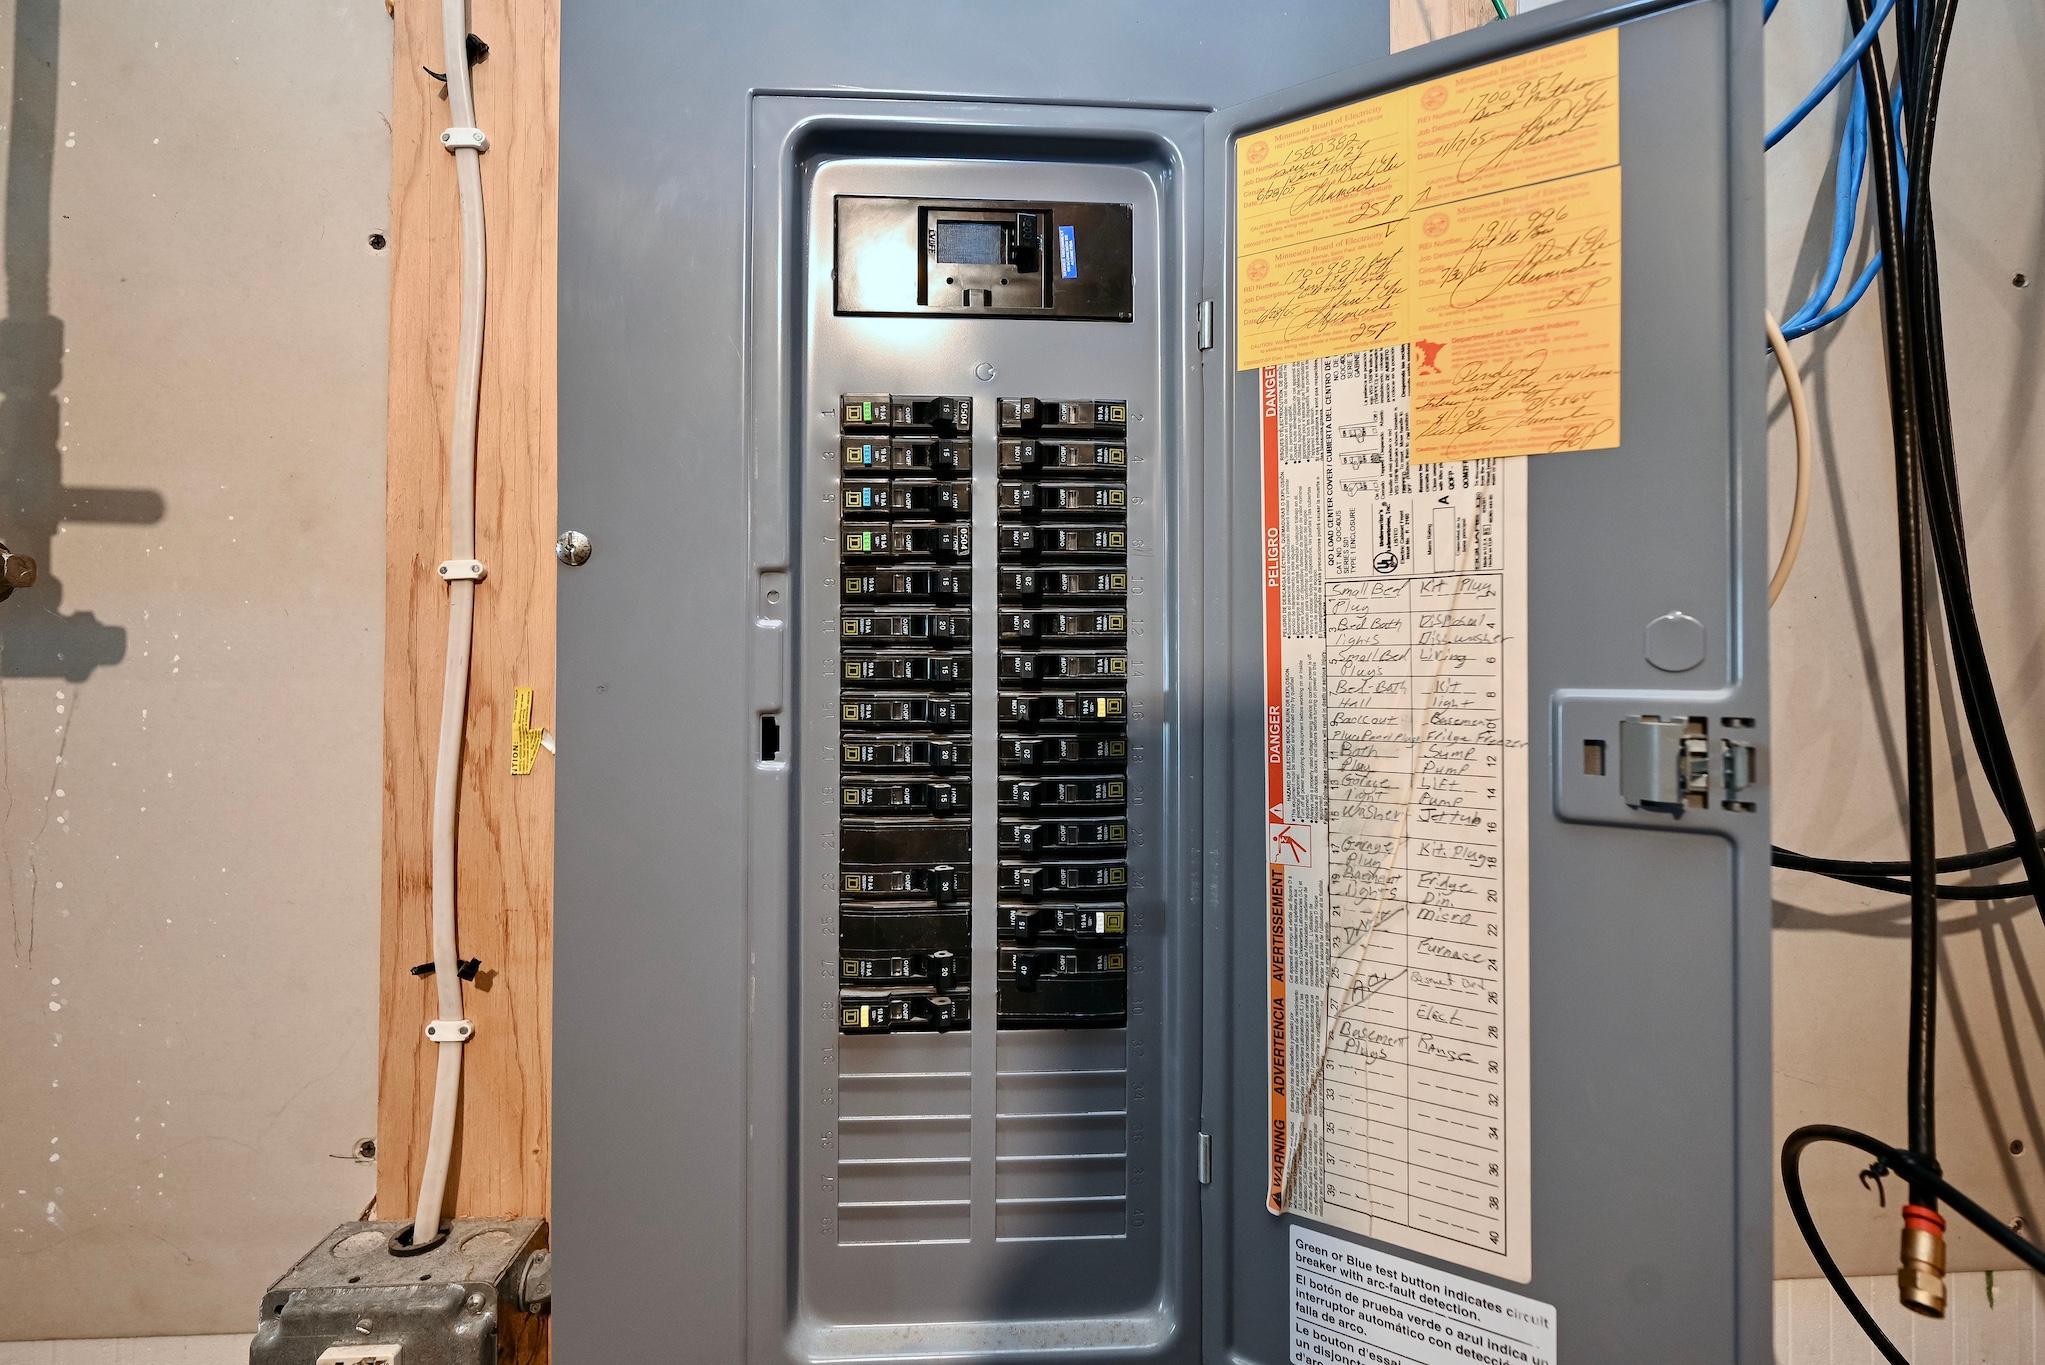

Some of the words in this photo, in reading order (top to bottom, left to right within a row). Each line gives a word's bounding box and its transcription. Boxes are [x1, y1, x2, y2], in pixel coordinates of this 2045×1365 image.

[1311, 120, 1334, 133] Board
[1334, 117, 1343, 126] of
[1344, 105, 1383, 123] Electricity
[1312, 243, 1334, 254] Board
[1335, 238, 1344, 247] of
[1344, 231, 1383, 246] Electricity
[1324, 360, 1332, 371] DE
[1324, 372, 1332, 405] CENTRO
[1325, 407, 1333, 422] DEL
[1325, 423, 1333, 463] CUBIERTA
[1326, 468, 1334, 496] COVER
[1438, 495, 1449, 505] A
[1326, 497, 1334, 528] CENTER
[960, 528, 968, 550] 0504
[1327, 529, 1335, 552] LOAD
[1267, 527, 1280, 588] PELIGRO
[1327, 553, 1335, 566] QO
[1486, 656, 1496, 664] 6
[1486, 691, 1496, 699] 8
[1269, 705, 1280, 764] DANGER
[1329, 751, 1338, 760] 11
[1487, 755, 1497, 767] 12
[1329, 779, 1339, 790] 13
[1487, 788, 1496, 799] 14
[1331, 810, 1340, 821] 15
[1487, 822, 1497, 834] 16
[1331, 843, 1340, 854] 17
[1487, 857, 1497, 868] 18
[1331, 873, 1340, 884] 19
[1487, 889, 1497, 902] 20
[1332, 905, 1341, 916] 21
[1272, 869, 1284, 983] AVERTISSEMENT
[1487, 924, 1498, 937] 22
[1332, 936, 1341, 949] 23
[1488, 959, 1498, 972] 24
[1331, 967, 1340, 979] 25
[1488, 991, 1498, 1005] 26
[1330, 999, 1339, 1011] 27
[1488, 1026, 1498, 1039] 28
[1273, 998, 1285, 1096] ADVERTENCIA
[1326, 1059, 1335, 1070] 31
[1488, 1061, 1498, 1073] 30
[1326, 1088, 1335, 1101] 33
[1489, 1093, 1499, 1107] 32
[1326, 1121, 1335, 1135] 35
[1489, 1127, 1499, 1140] 34
[1273, 1119, 1285, 1188] WARNING
[1326, 1152, 1335, 1165] 37
[1489, 1163, 1500, 1176] 36
[1326, 1184, 1336, 1197] 39
[1489, 1197, 1500, 1210] 38
[1489, 1232, 1500, 1245] 40
[1295, 1238, 1328, 1257] Green
[1331, 1252, 1343, 1262] or
[1346, 1254, 1373, 1272] Blue
[1375, 1264, 1398, 1280] test
[1401, 1272, 1441, 1293] button
[1444, 1285, 1502, 1314] indicates
[1506, 1307, 1550, 1329] circuit
[1295, 1251, 1337, 1273] breaker
[1340, 1267, 1364, 1283] with
[1366, 1277, 1416, 1300] arc-fault
[1419, 1293, 1481, 1322] detection.
[1295, 1301, 1319, 1318] falla
[1321, 1312, 1335, 1324] de
[1338, 1320, 1368, 1336] arco.
[1295, 1287, 1355, 1317] interruptor
[1358, 1311, 1425, 1341] automático
[1428, 1336, 1452, 1351] con
[1295, 1274, 1306, 1285] El
[1309, 1278, 1342, 1298] botón
[1345, 1292, 1359, 1304] de
[1362, 1298, 1404, 1319] prueba
[1407, 1313, 1441, 1332] verde
[1445, 1326, 1453, 1336] o
[1457, 1330, 1483, 1346] azul
[1487, 1338, 1528, 1361] indica
[1532, 1356, 1549, 1365] un
[1295, 1322, 1310, 1336] Le
[1312, 1329, 1354, 1353] bouton
[1358, 1347, 1401, 1365] d'essai
[1295, 1338, 1310, 1350] un
